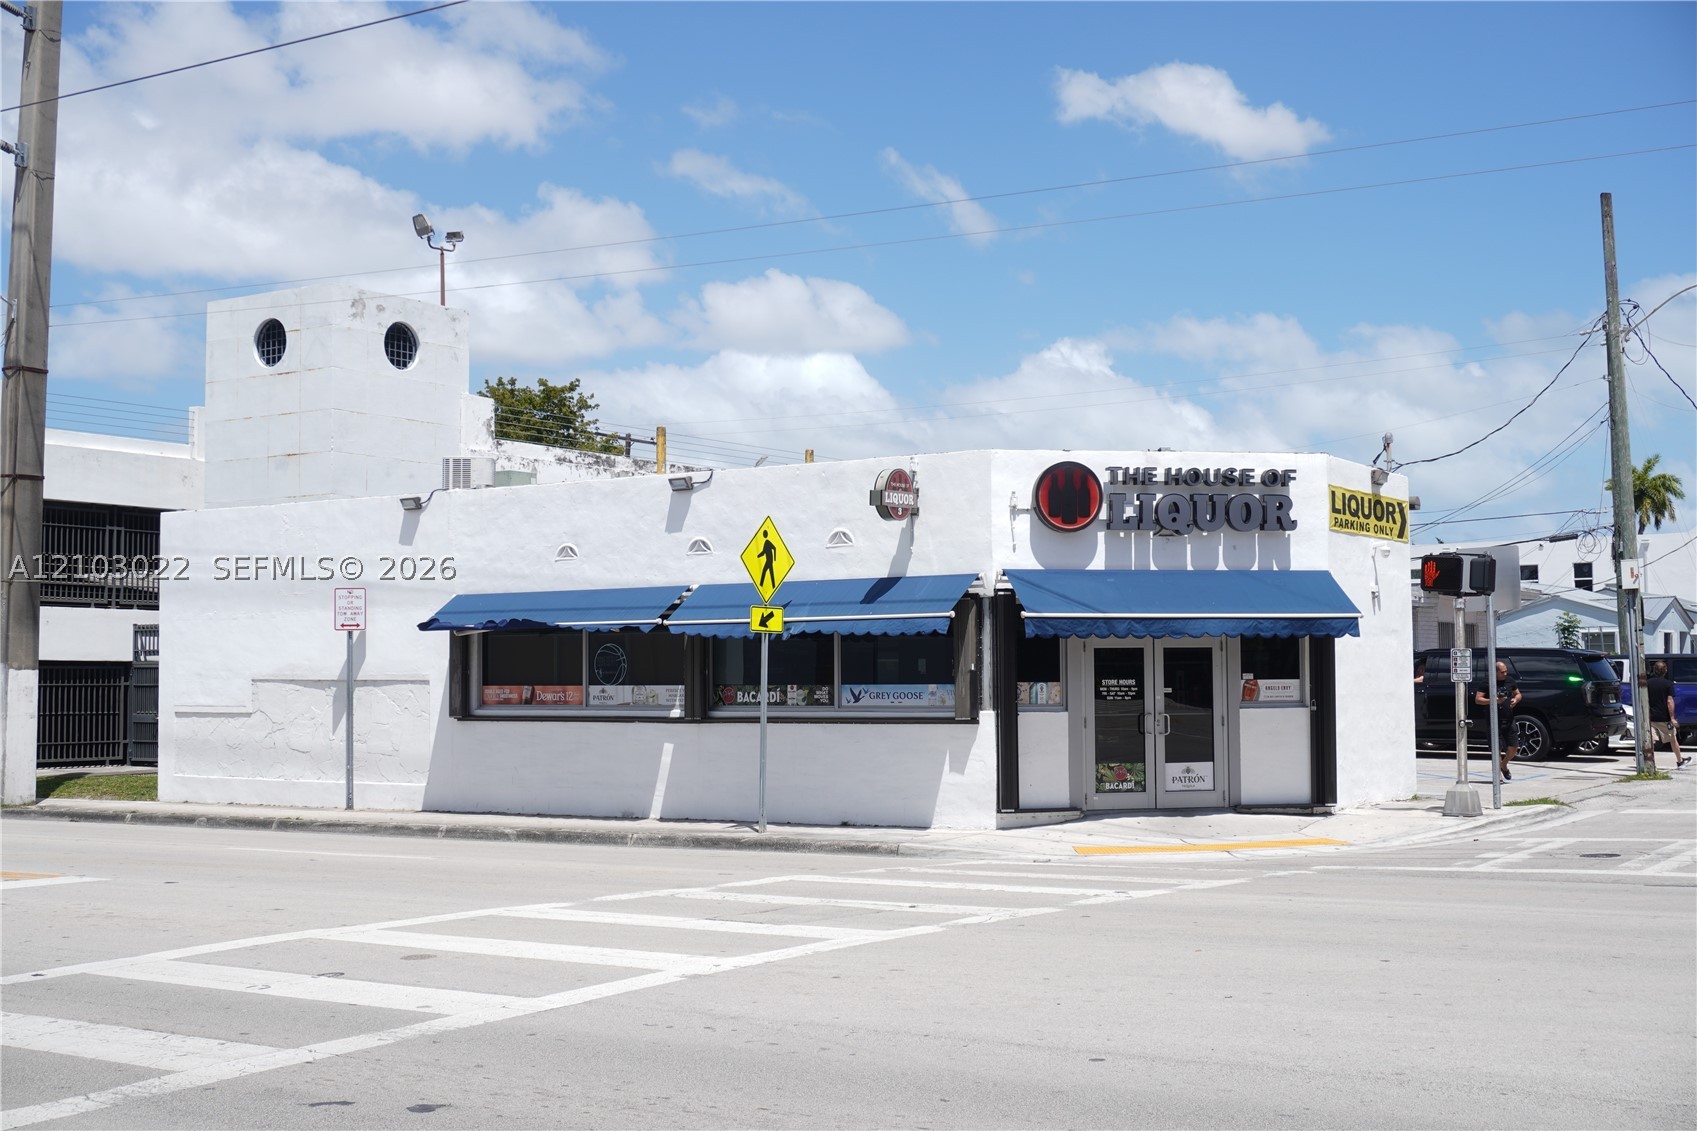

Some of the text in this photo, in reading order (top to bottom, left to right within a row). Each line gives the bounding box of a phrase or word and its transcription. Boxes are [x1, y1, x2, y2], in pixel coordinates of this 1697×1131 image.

[1105, 466, 1297, 487] THE HOUSE OF
[885, 491, 914, 506] LIQUOR
[1106, 492, 1298, 535] LIQUOR
[1331, 490, 1397, 525] LIQUOR
[1334, 517, 1394, 537] PARKING ONLY
[536, 690, 565, 701] Dewar's
[566, 690, 574, 701] 12
[868, 691, 924, 700] GREY GOOSE
[1171, 773, 1206, 784] PATRÓN
